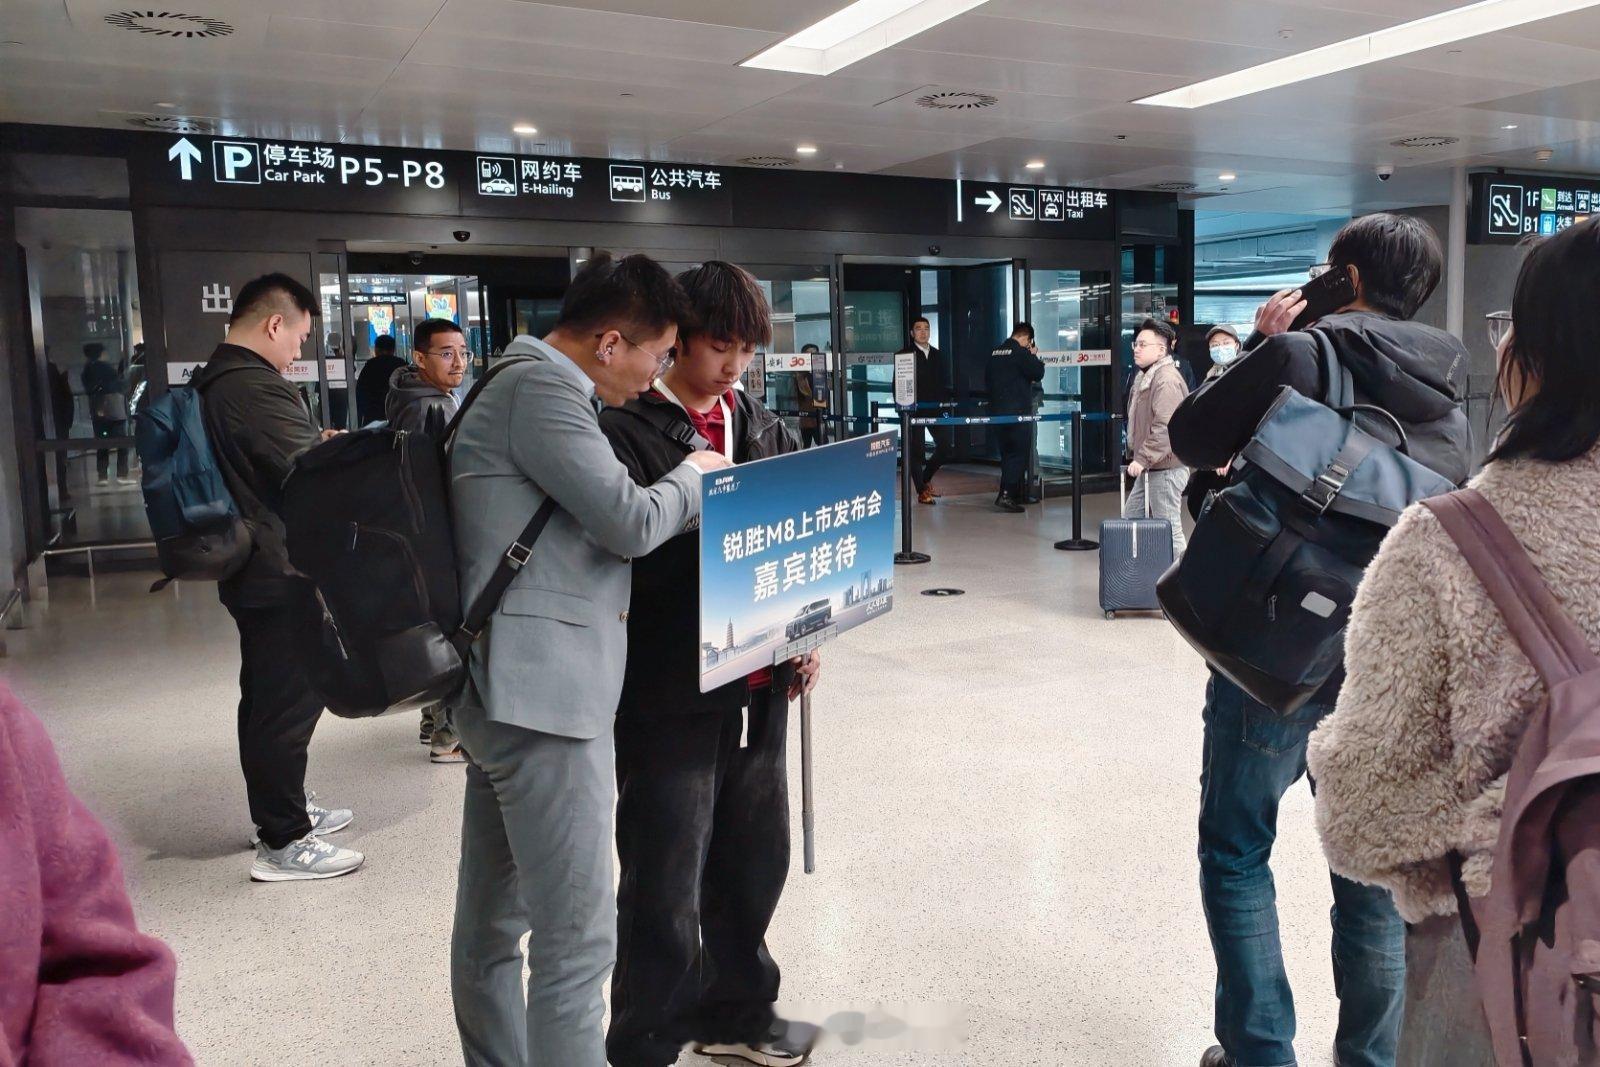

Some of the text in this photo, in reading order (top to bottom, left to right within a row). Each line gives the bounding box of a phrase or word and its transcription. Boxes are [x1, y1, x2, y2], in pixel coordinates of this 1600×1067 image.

[263, 143, 336, 169] 停车场
[264, 169, 326, 184] Car Park
[340, 156, 446, 190] P5-P8
[521, 160, 583, 183] 网约车
[650, 168, 723, 190] 公共汽车
[522, 182, 575, 198] E-Hailing
[651, 189, 672, 201] Bus
[1557, 191, 1573, 203] 到达
[1040, 193, 1063, 204] TAXI
[1066, 191, 1108, 208] 出租车
[1526, 191, 1540, 207] 1F
[1591, 193, 1600, 205] 出
[1066, 208, 1085, 219] Taxi
[1523, 216, 1538, 232] B1
[1556, 216, 1573, 228] 火车
[202, 283, 233, 314] 出
[789, 356, 806, 368] 30
[722, 489, 882, 563] 锐胜M8上市发布会
[753, 534, 858, 602] 嘉宾接待
